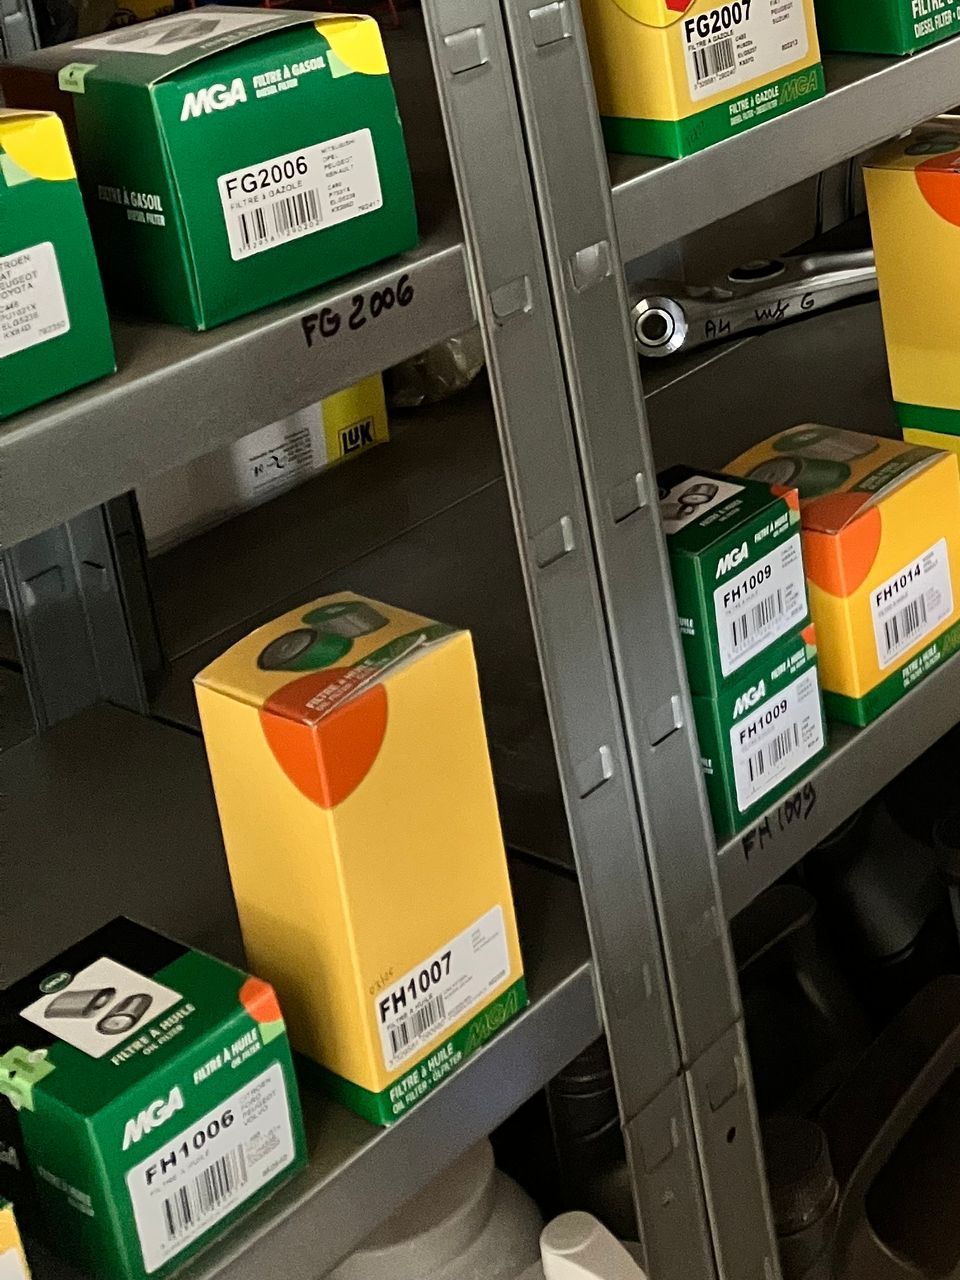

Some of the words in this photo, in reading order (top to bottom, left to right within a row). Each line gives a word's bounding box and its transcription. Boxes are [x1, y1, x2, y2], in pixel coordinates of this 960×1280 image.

[688, 37, 708, 52] FILTRE
[252, 68, 282, 89] FILTRE
[291, 55, 327, 76] GASOIL
[779, 70, 819, 106] MGA
[180, 77, 248, 122] MGA
[754, 85, 780, 105] GAZOLE
[225, 155, 309, 200] FG2006
[229, 192, 260, 211] FILTRE
[269, 179, 303, 198] GAZOLE
[130, 190, 164, 213] GASOIL
[301, 307, 342, 349] FG
[348, 273, 416, 332] 2006
[715, 540, 749, 581] MGA
[723, 563, 773, 609] FH1009
[876, 562, 922, 608] FH1014
[732, 678, 766, 721] MGA
[738, 699, 788, 746] FH1009
[378, 949, 452, 1025] FH1007
[110, 1033, 150, 1067] FILTRE
[159, 1002, 196, 1032] HUILE
[464, 989, 519, 1056] MGA
[141, 1042, 159, 1057] OIL
[193, 1053, 223, 1086] FILTRE
[230, 1027, 259, 1056] HUILE
[389, 1070, 420, 1103] FILTRE
[427, 1041, 455, 1071] HUILE
[122, 1086, 185, 1152] MGA
[391, 1099, 406, 1115] OIL
[405, 1080, 428, 1104] FILTER
[144, 1108, 236, 1187] FH1006
